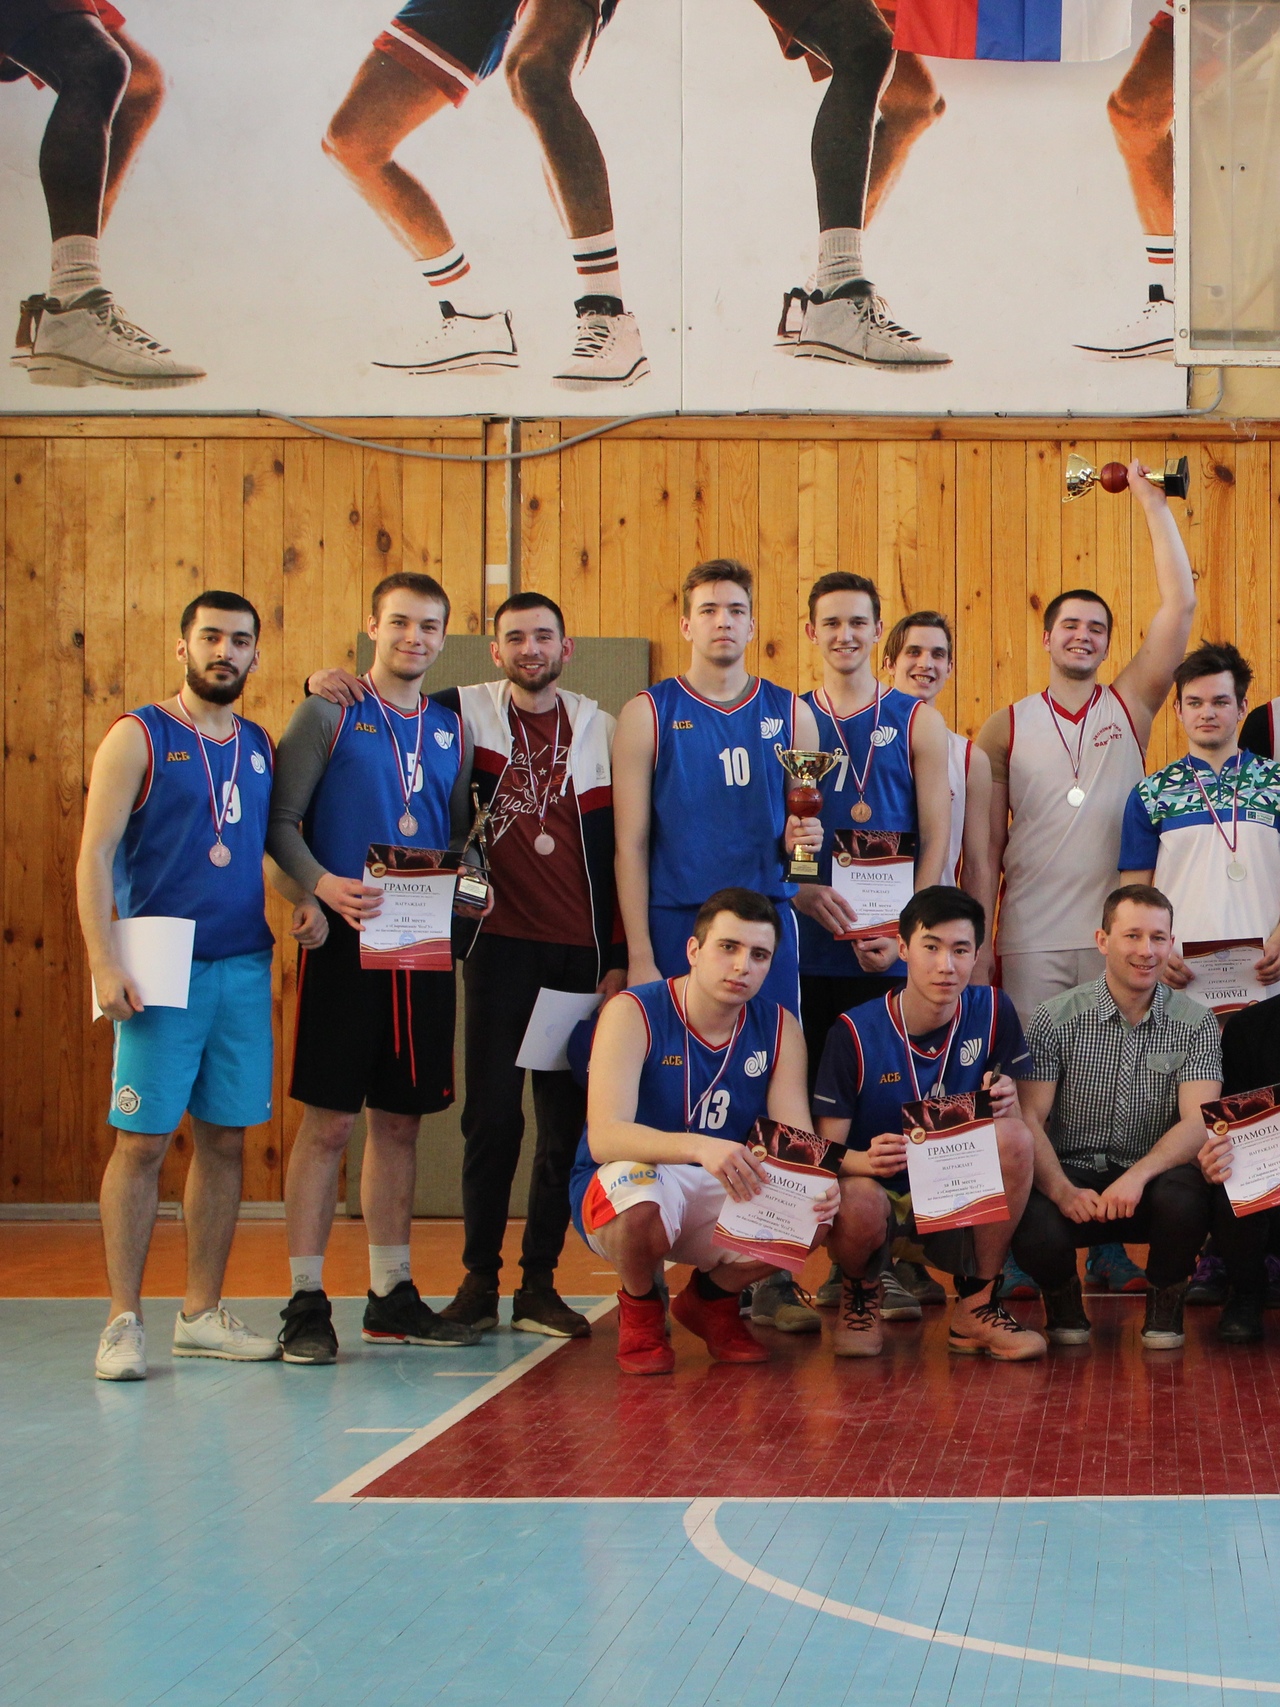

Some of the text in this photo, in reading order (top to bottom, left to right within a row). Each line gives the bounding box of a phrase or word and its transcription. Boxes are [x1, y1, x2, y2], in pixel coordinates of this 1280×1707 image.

[672, 720, 693, 730] АСБ
[406, 752, 424, 793] 5
[719, 747, 751, 787] 10
[836, 755, 850, 792] 7
[222, 781, 242, 824] 9
[851, 871, 894, 881] ГРАМОТА
[384, 883, 432, 892] ГРАМОТА
[879, 1071, 901, 1084] АСБ
[699, 1089, 731, 1130] 13
[1232, 1124, 1280, 1145] ГРАМОТА
[927, 1141, 976, 1157] ГРАМОТА
[766, 1172, 807, 1194] РАМОТА
